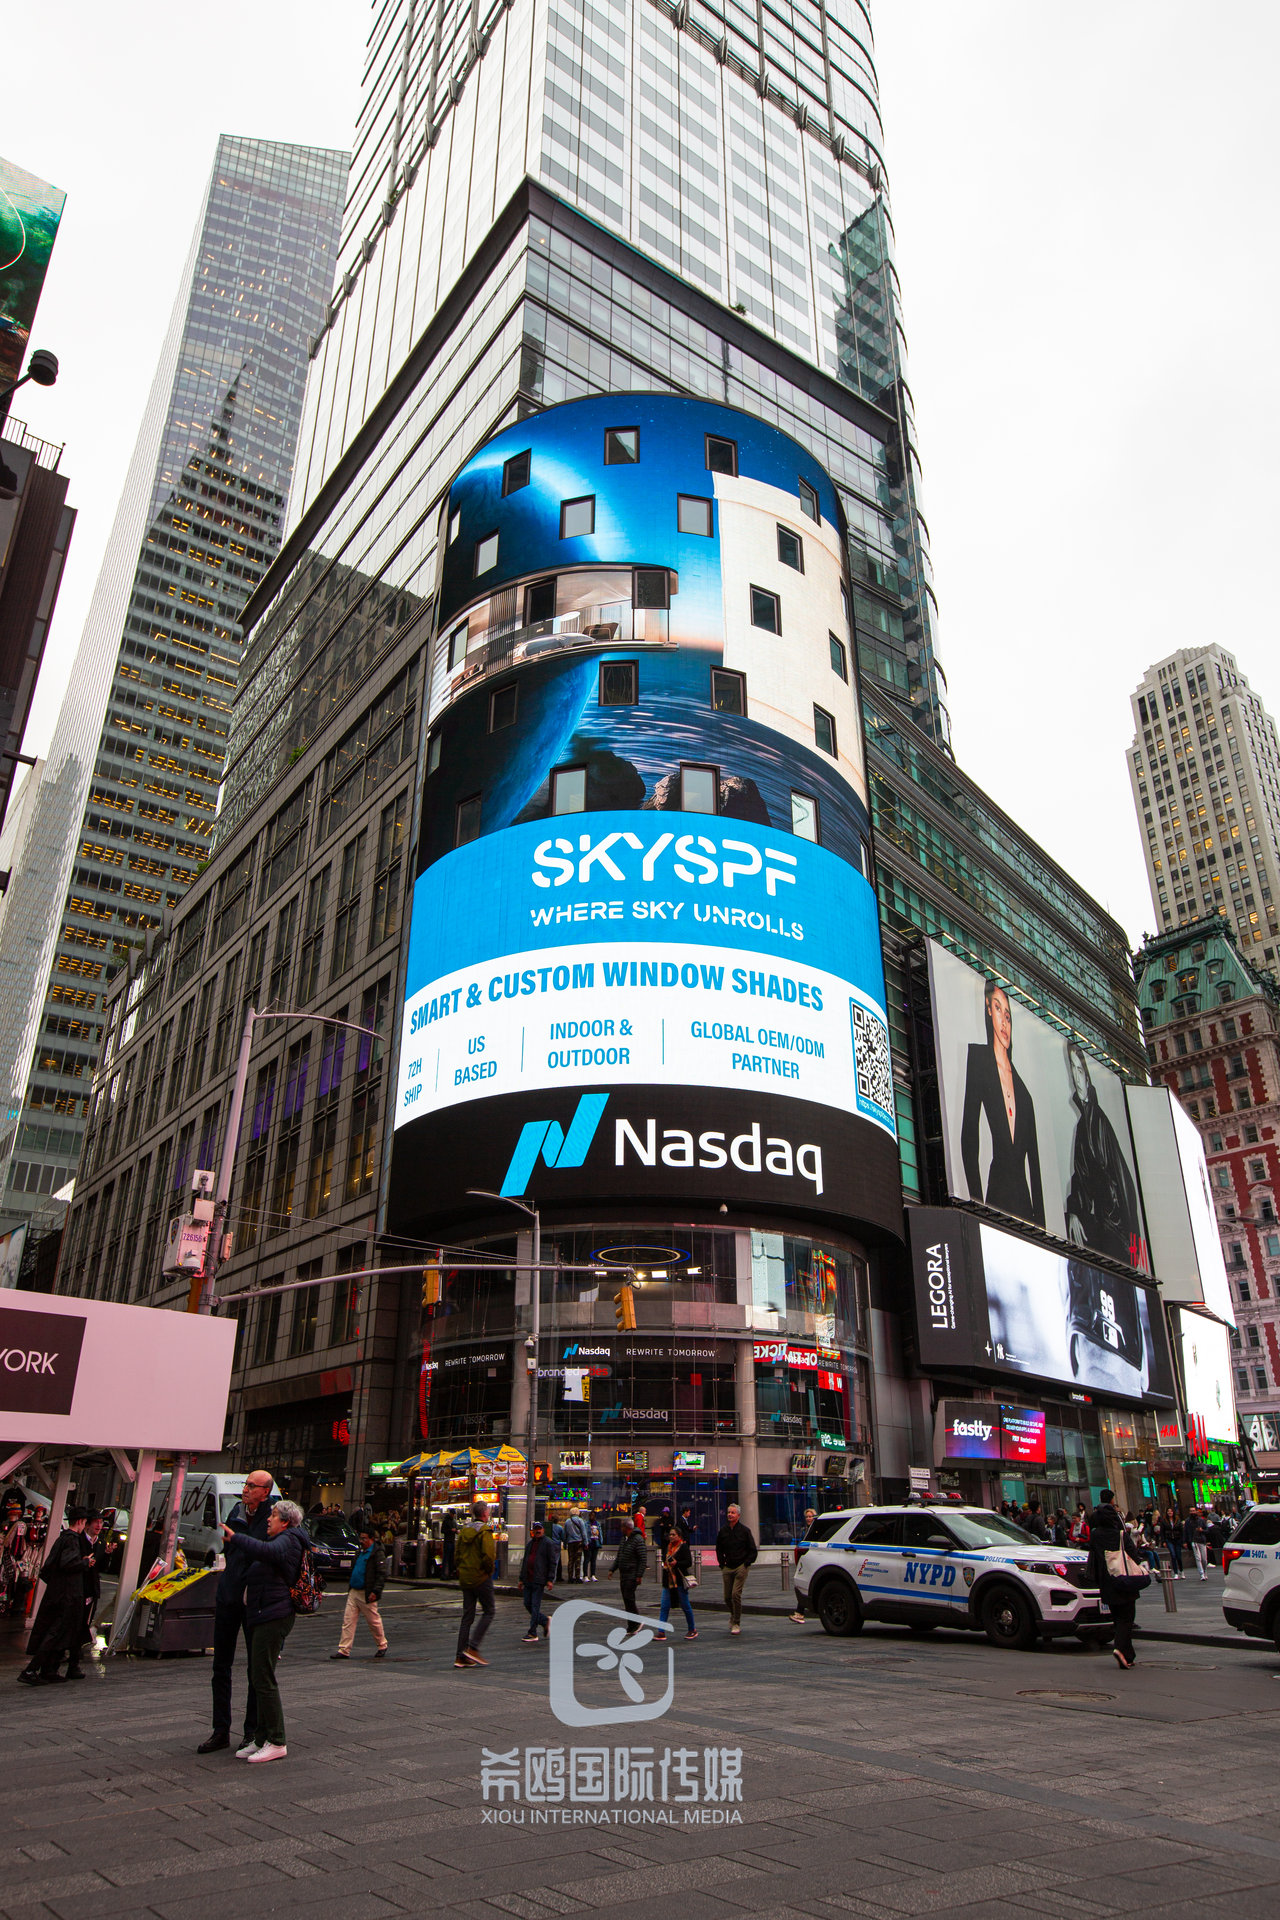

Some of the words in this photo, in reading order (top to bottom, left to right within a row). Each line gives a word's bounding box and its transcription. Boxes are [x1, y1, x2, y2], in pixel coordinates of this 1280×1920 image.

[531, 832, 798, 898] SKYSPF
[530, 901, 624, 928] WHERE
[632, 901, 685, 920] SKY
[693, 903, 805, 941] UNROLLS
[409, 988, 462, 1036] SMART
[465, 982, 483, 1010] &
[488, 963, 595, 1003] CUSTOM
[603, 961, 725, 992] WINDOW
[732, 969, 824, 1012] SHADES
[549, 1020, 615, 1041] INDOOR
[619, 1019, 634, 1037] &
[690, 1021, 755, 1045] GLOBAL
[757, 1027, 826, 1060] OEM/ODM
[467, 1035, 486, 1055] US
[547, 1047, 631, 1069] OUTDOOR
[407, 1057, 423, 1080] 72H
[453, 1060, 498, 1087] BASED
[731, 1052, 801, 1080] PARTNER
[403, 1083, 423, 1107] SHIP
[614, 1118, 825, 1196] Nasdaq
[925, 1243, 949, 1329] LEGORA
[579, 1346, 611, 1357] Nasdaq
[626, 1348, 664, 1356] REWRITE
[668, 1348, 715, 1357] TOMORROW
[623, 1407, 669, 1422] Nasdaq
[904, 1561, 956, 1588] NYPD
